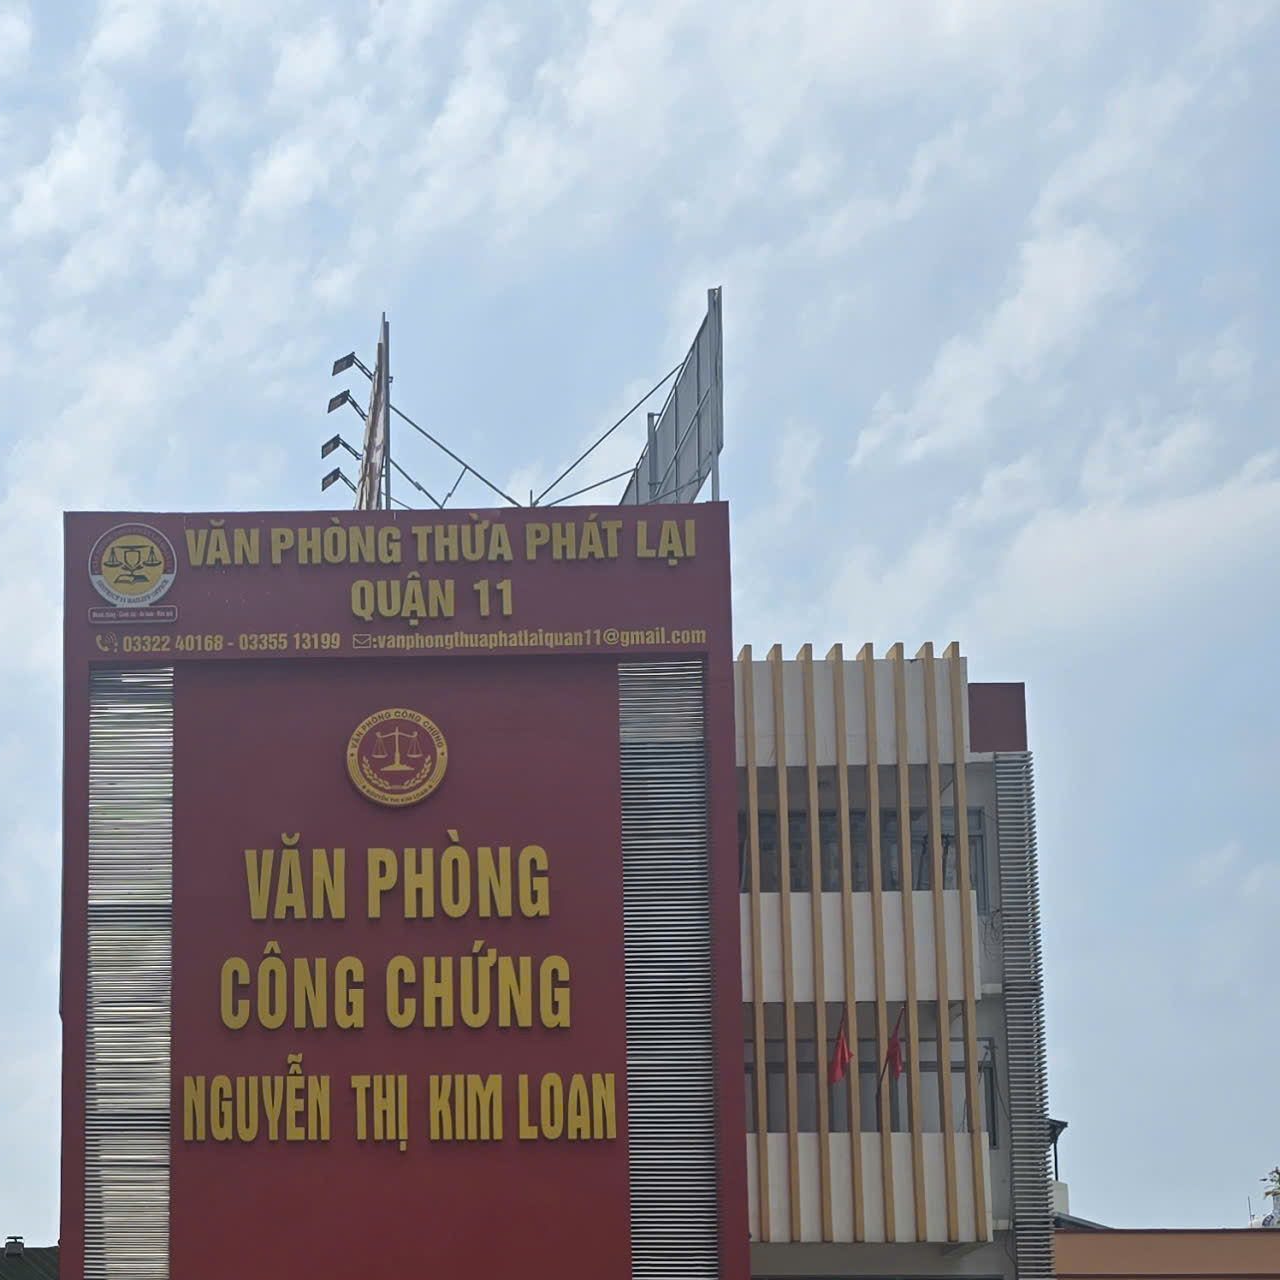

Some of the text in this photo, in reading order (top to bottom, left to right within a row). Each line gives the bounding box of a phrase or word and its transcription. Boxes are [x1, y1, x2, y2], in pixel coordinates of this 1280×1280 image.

[186, 521, 260, 567] VĂN
[272, 518, 401, 566] PHÒNG
[412, 514, 512, 564] THỪA
[527, 517, 622, 560] PHÁT
[637, 519, 697, 566] LẠI
[351, 573, 513, 625] QUẬN 11
[123, 635, 170, 652] 03322
[176, 635, 224, 652] 40168
[240, 634, 287, 651] 03355
[294, 633, 340, 650] 13199
[244, 830, 550, 921] VĂN PHÒNG
[220, 940, 571, 1029] CÔNG CHỨNG
[183, 1055, 617, 1152] NGUYỄN THỊ KIM LOAN
